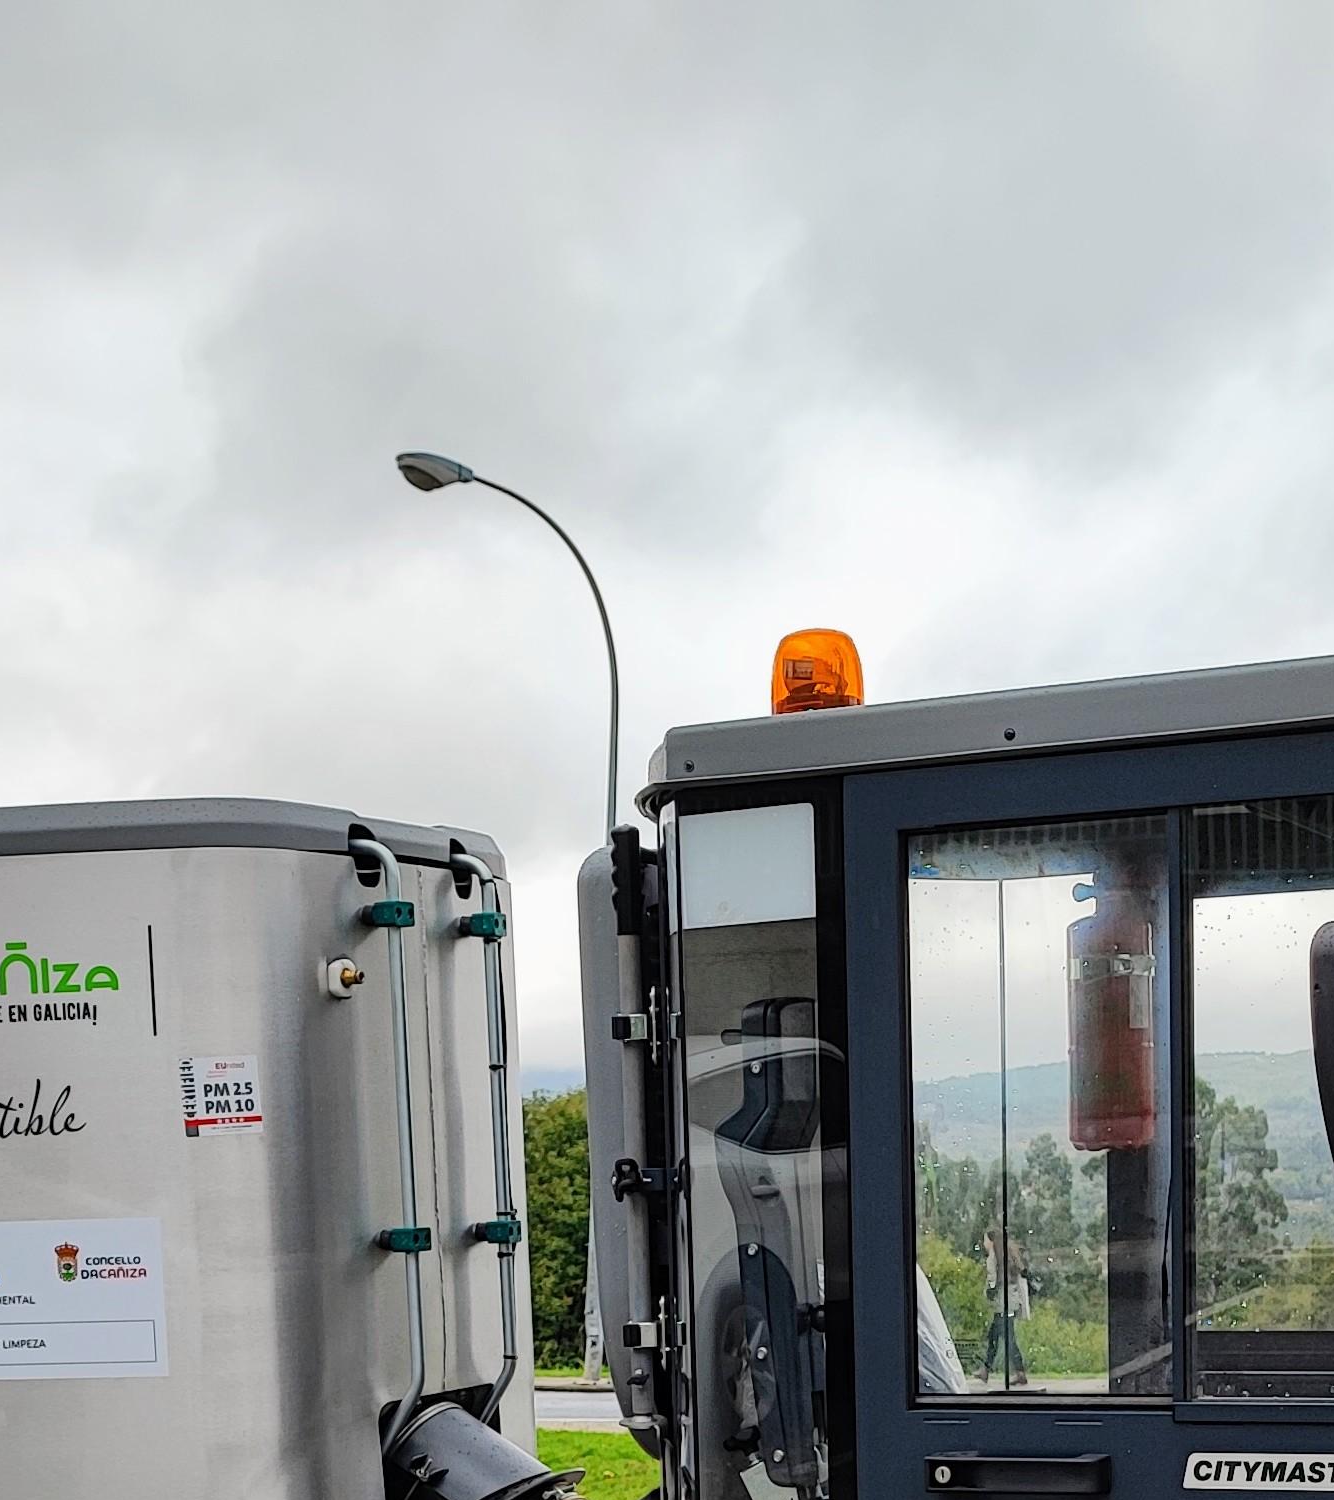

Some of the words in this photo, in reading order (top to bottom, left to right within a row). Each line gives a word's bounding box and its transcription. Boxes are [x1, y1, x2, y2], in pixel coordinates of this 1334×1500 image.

[8, 1004, 28, 1023] EN
[33, 1002, 97, 1025] GALICIA!
[203, 1083, 230, 1097] PM
[233, 1082, 253, 1095] 2.5
[205, 1100, 231, 1114] PM
[234, 1099, 255, 1112] 10
[85, 1256, 141, 1266] CONCELLO
[2, 1338, 47, 1349] LIMPEZA
